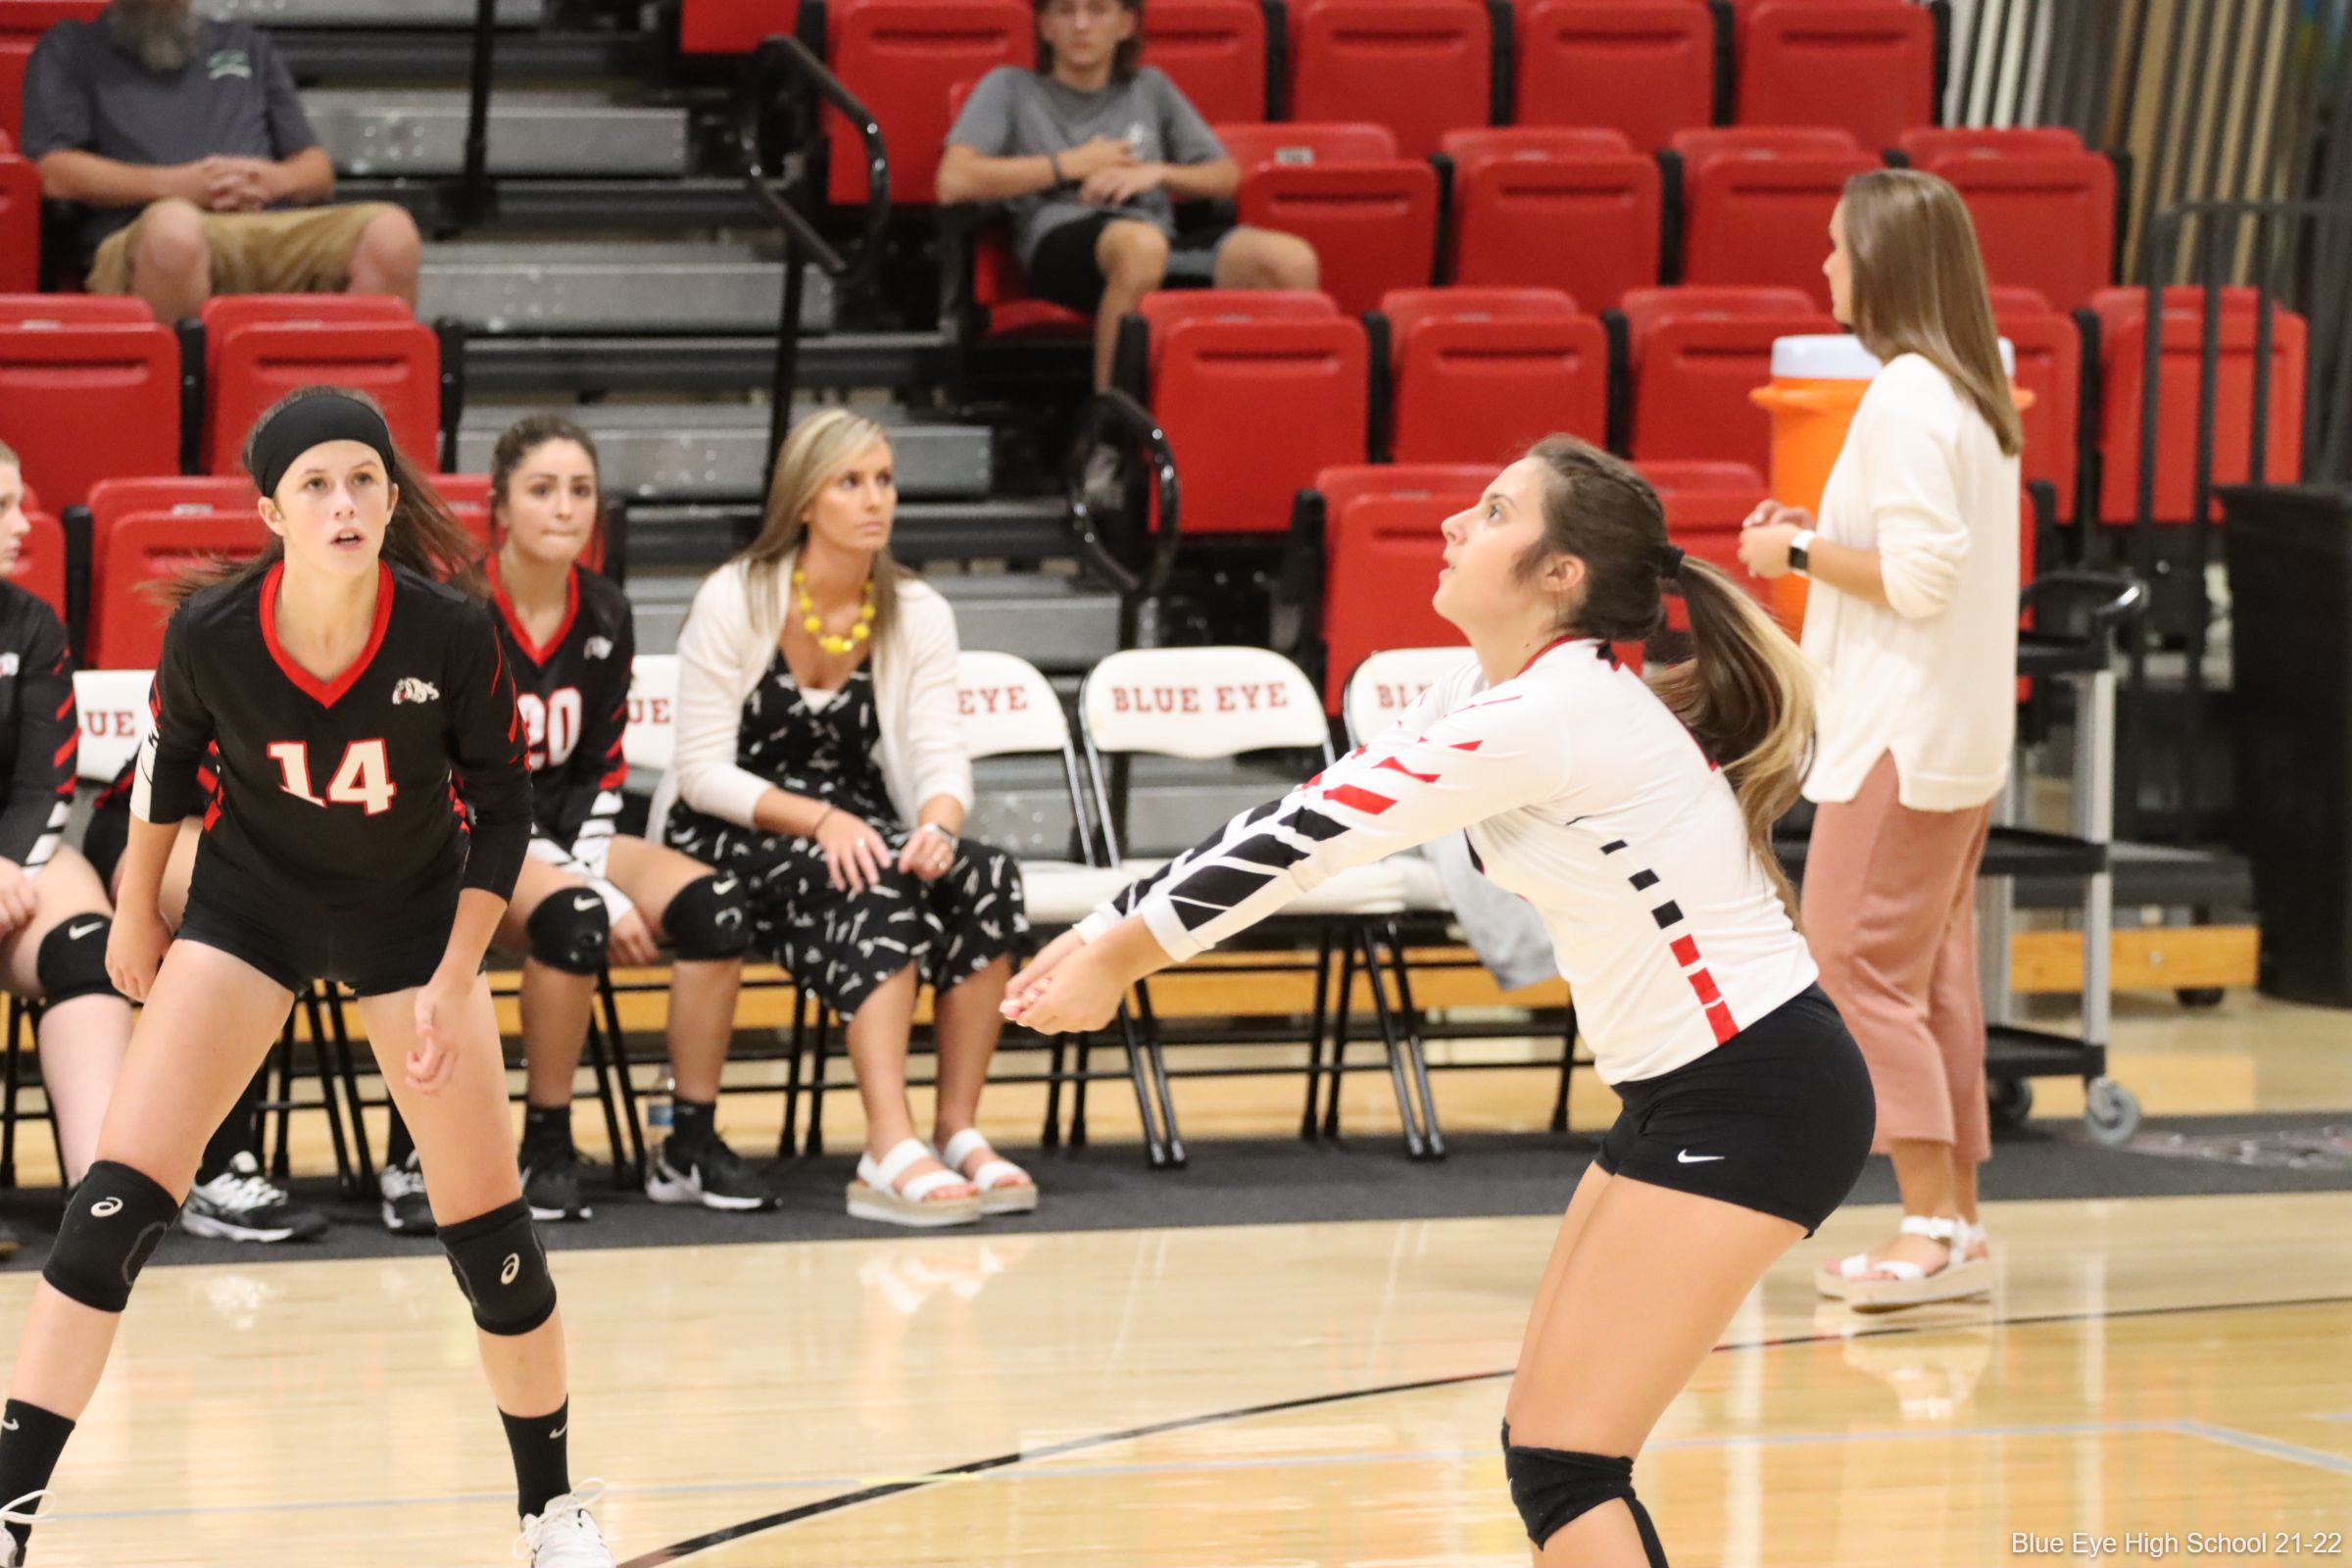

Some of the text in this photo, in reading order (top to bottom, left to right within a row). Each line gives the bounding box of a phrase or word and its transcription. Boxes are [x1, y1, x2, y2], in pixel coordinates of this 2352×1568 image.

[957, 685, 1028, 714] EYE
[1111, 682, 1289, 712] BLUE EYE
[1376, 683, 1433, 710] BL
[516, 685, 582, 772] 20
[267, 737, 398, 816] 14
